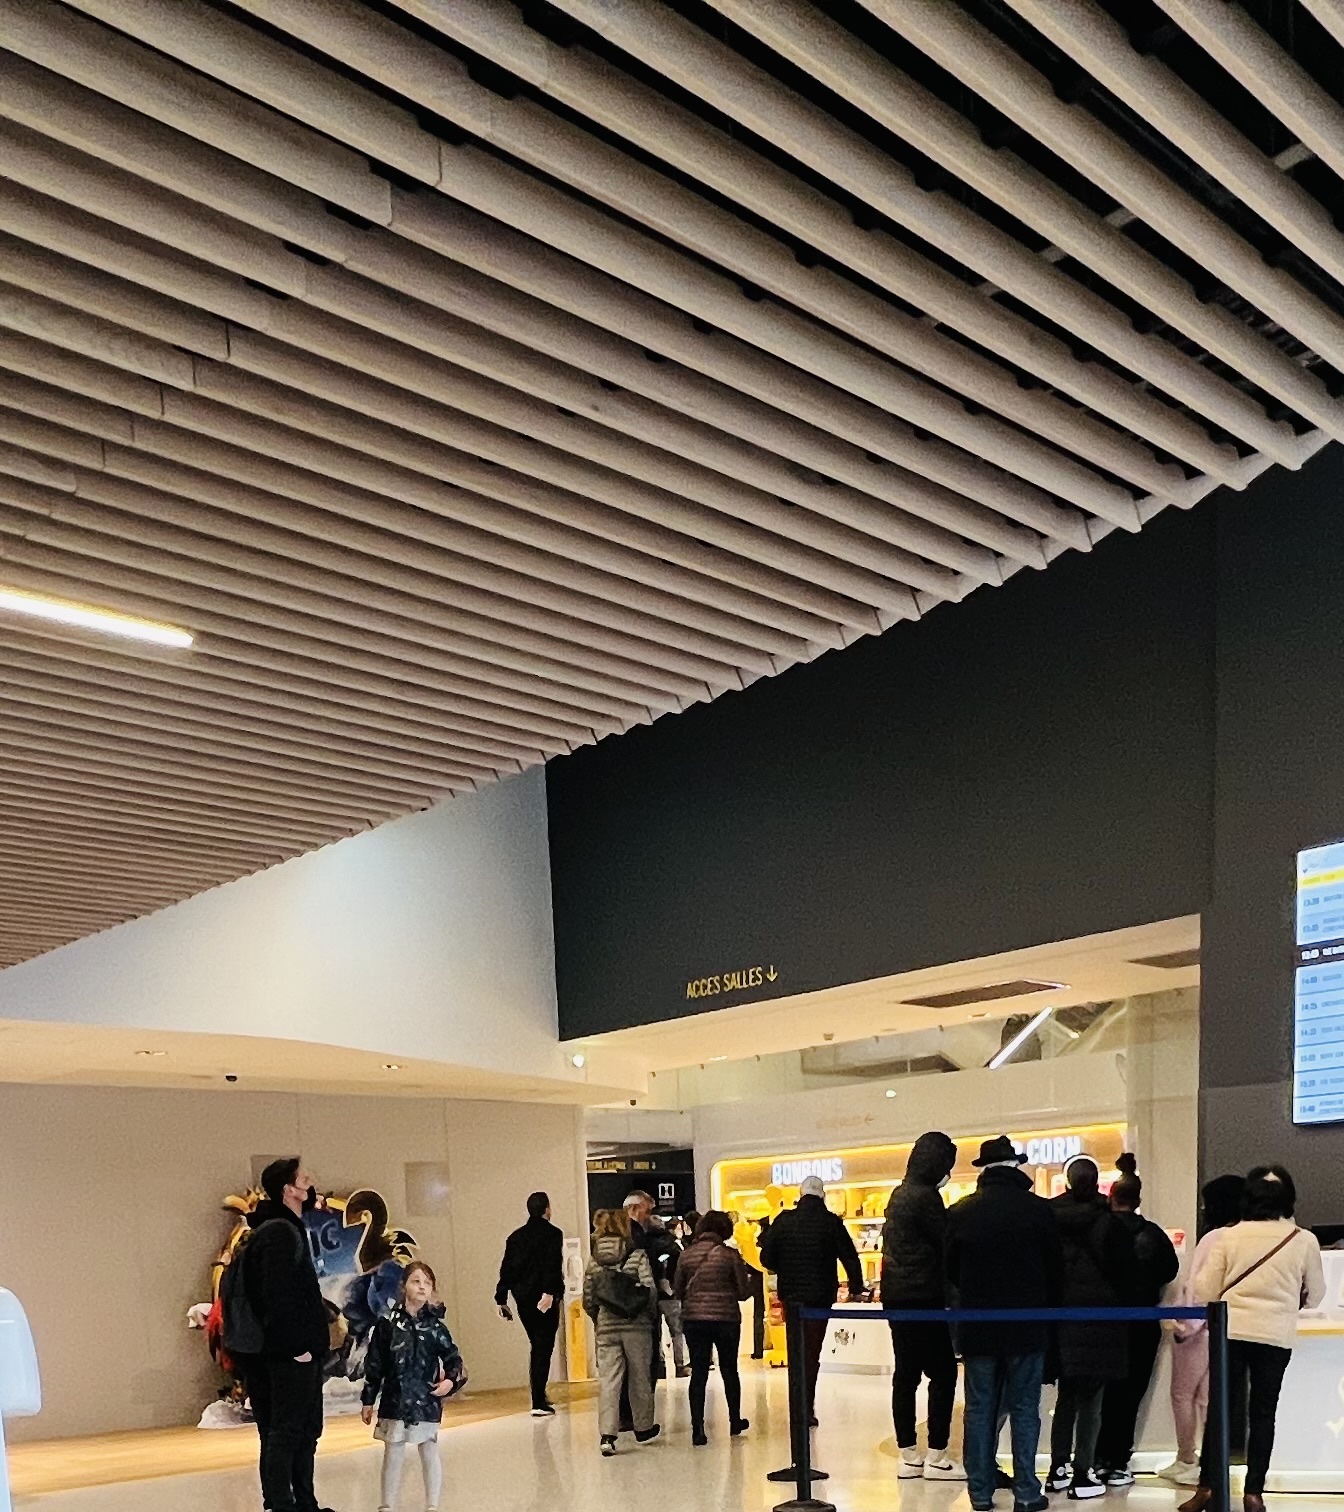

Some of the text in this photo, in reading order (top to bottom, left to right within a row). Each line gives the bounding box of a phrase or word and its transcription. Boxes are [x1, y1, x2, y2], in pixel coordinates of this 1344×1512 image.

[686, 966, 763, 999] ACCES SALLES
[1027, 1135, 1081, 1165] CORN
[771, 1157, 843, 1186] BONBONS
